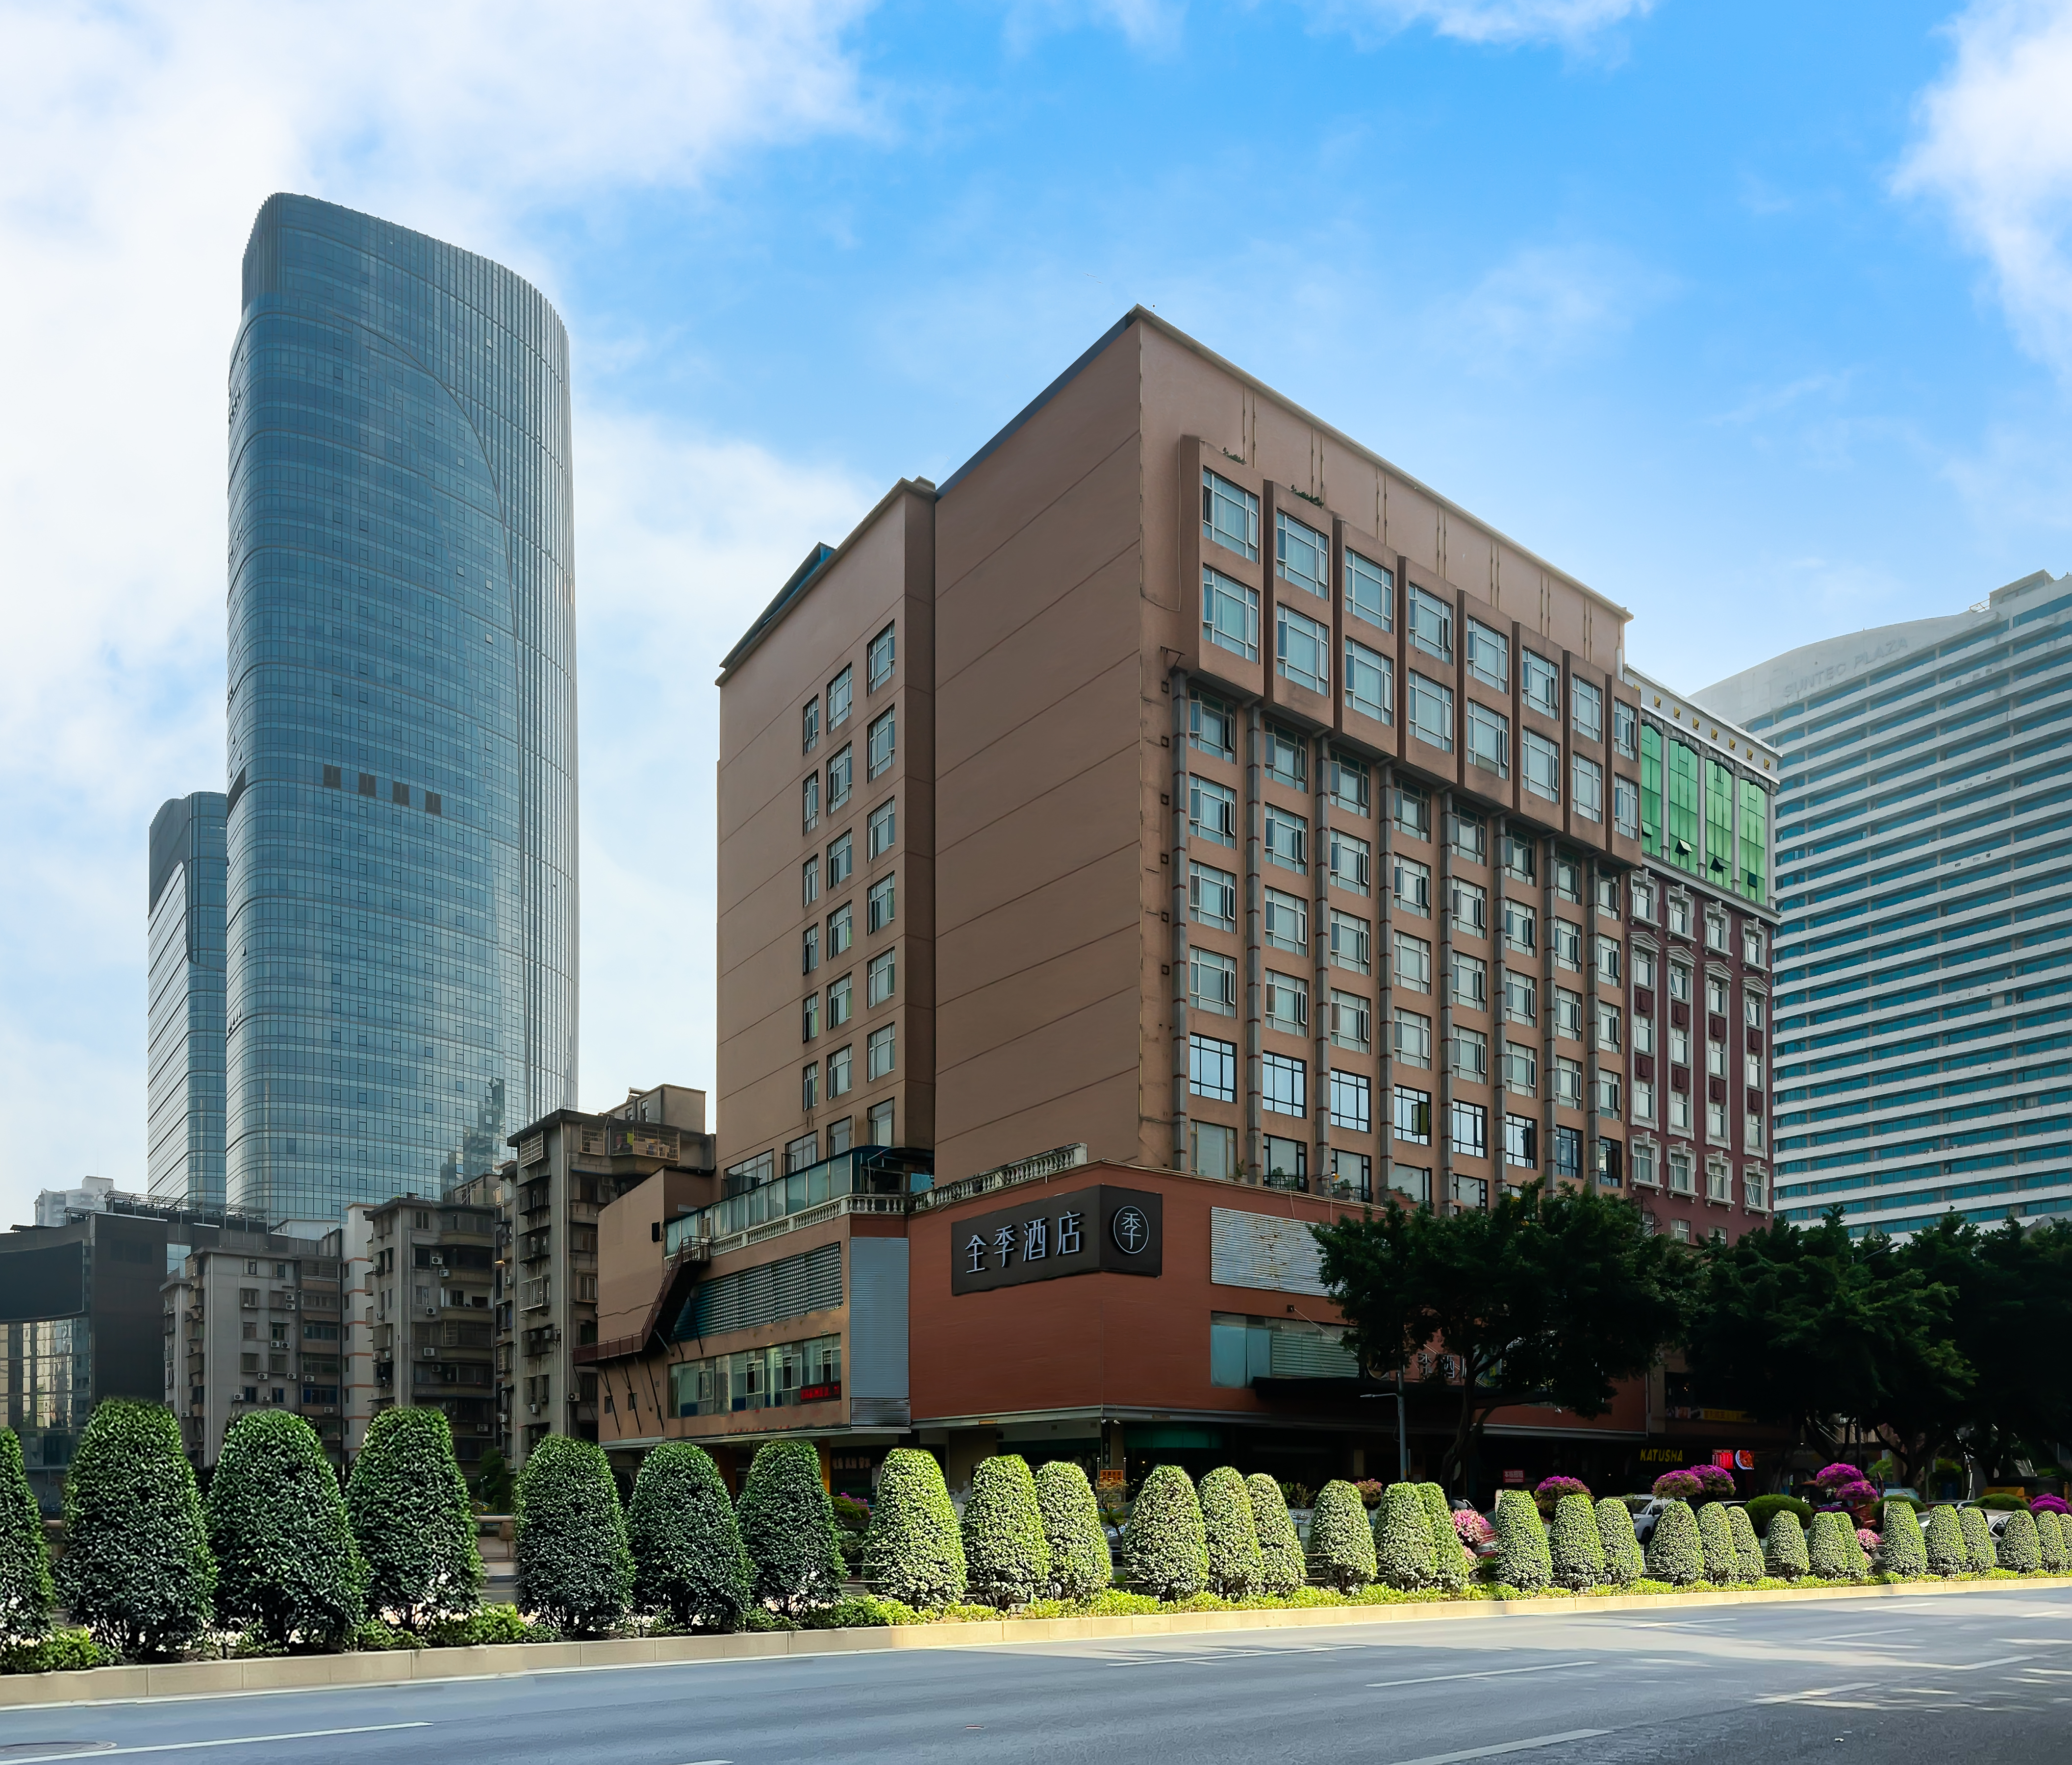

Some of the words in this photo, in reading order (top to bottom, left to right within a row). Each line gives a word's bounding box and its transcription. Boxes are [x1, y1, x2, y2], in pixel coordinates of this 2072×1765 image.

[1854, 636, 1908, 669] PLAZA
[965, 1211, 1081, 1274] 全季酒店
[1121, 1212, 1142, 1250] 季
[1640, 1448, 1683, 1462] KATUSHA
